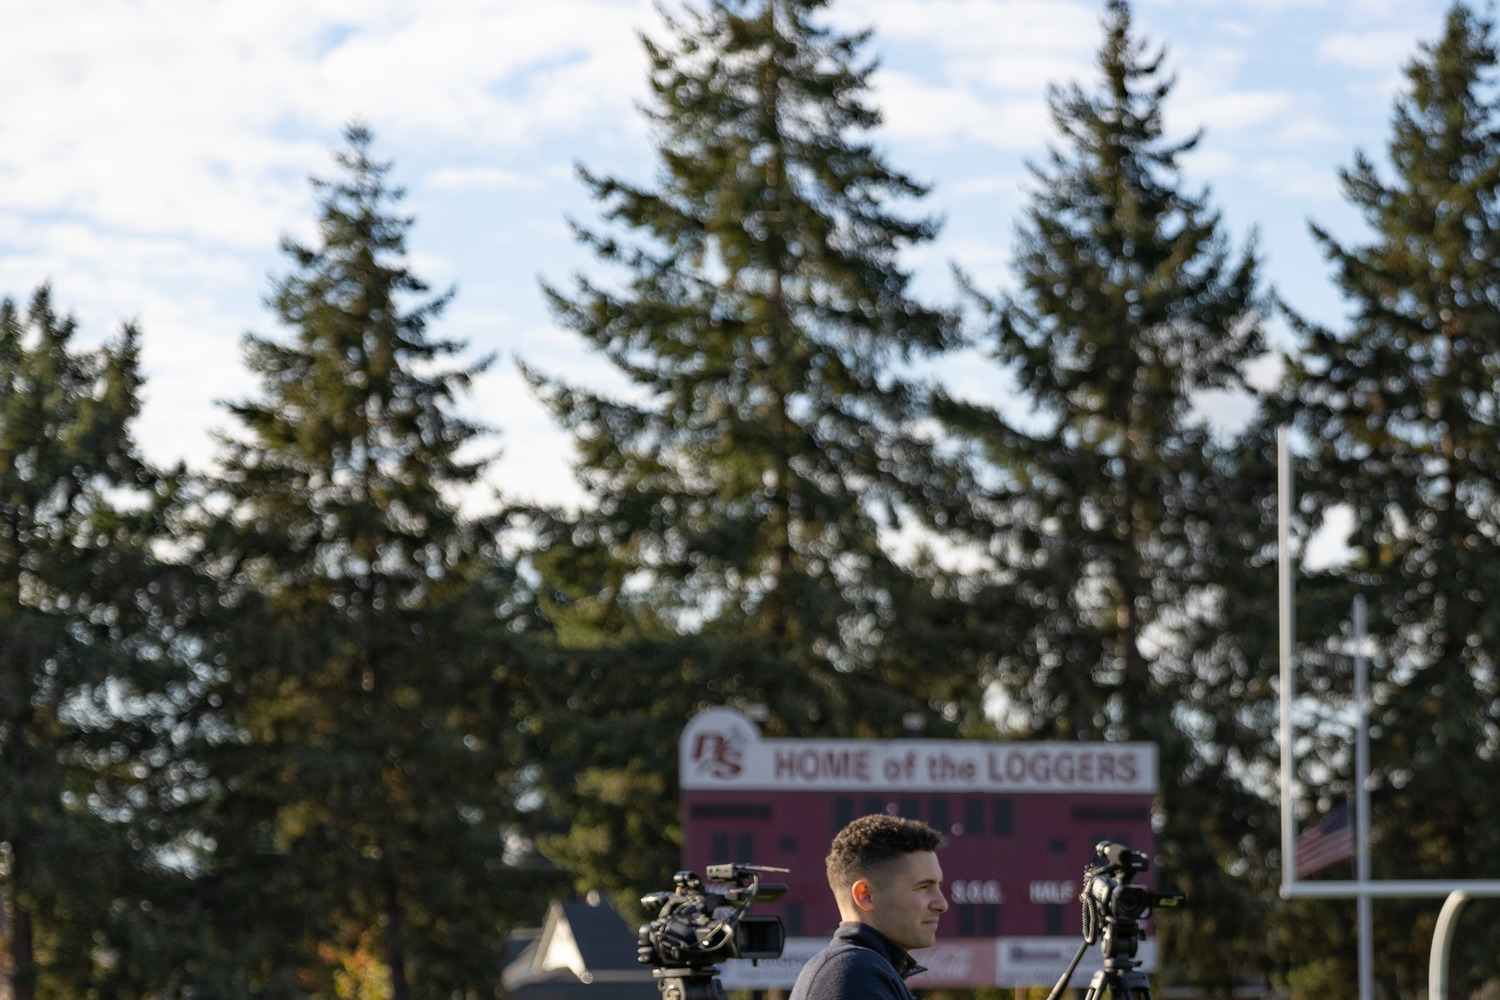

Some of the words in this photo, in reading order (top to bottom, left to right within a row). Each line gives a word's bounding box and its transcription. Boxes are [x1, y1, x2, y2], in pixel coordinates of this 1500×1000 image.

[774, 749, 871, 781] HOME
[883, 749, 916, 781] of
[927, 753, 976, 781] the
[987, 751, 1139, 784] LOGGERS
[1029, 879, 1076, 904] HALF
